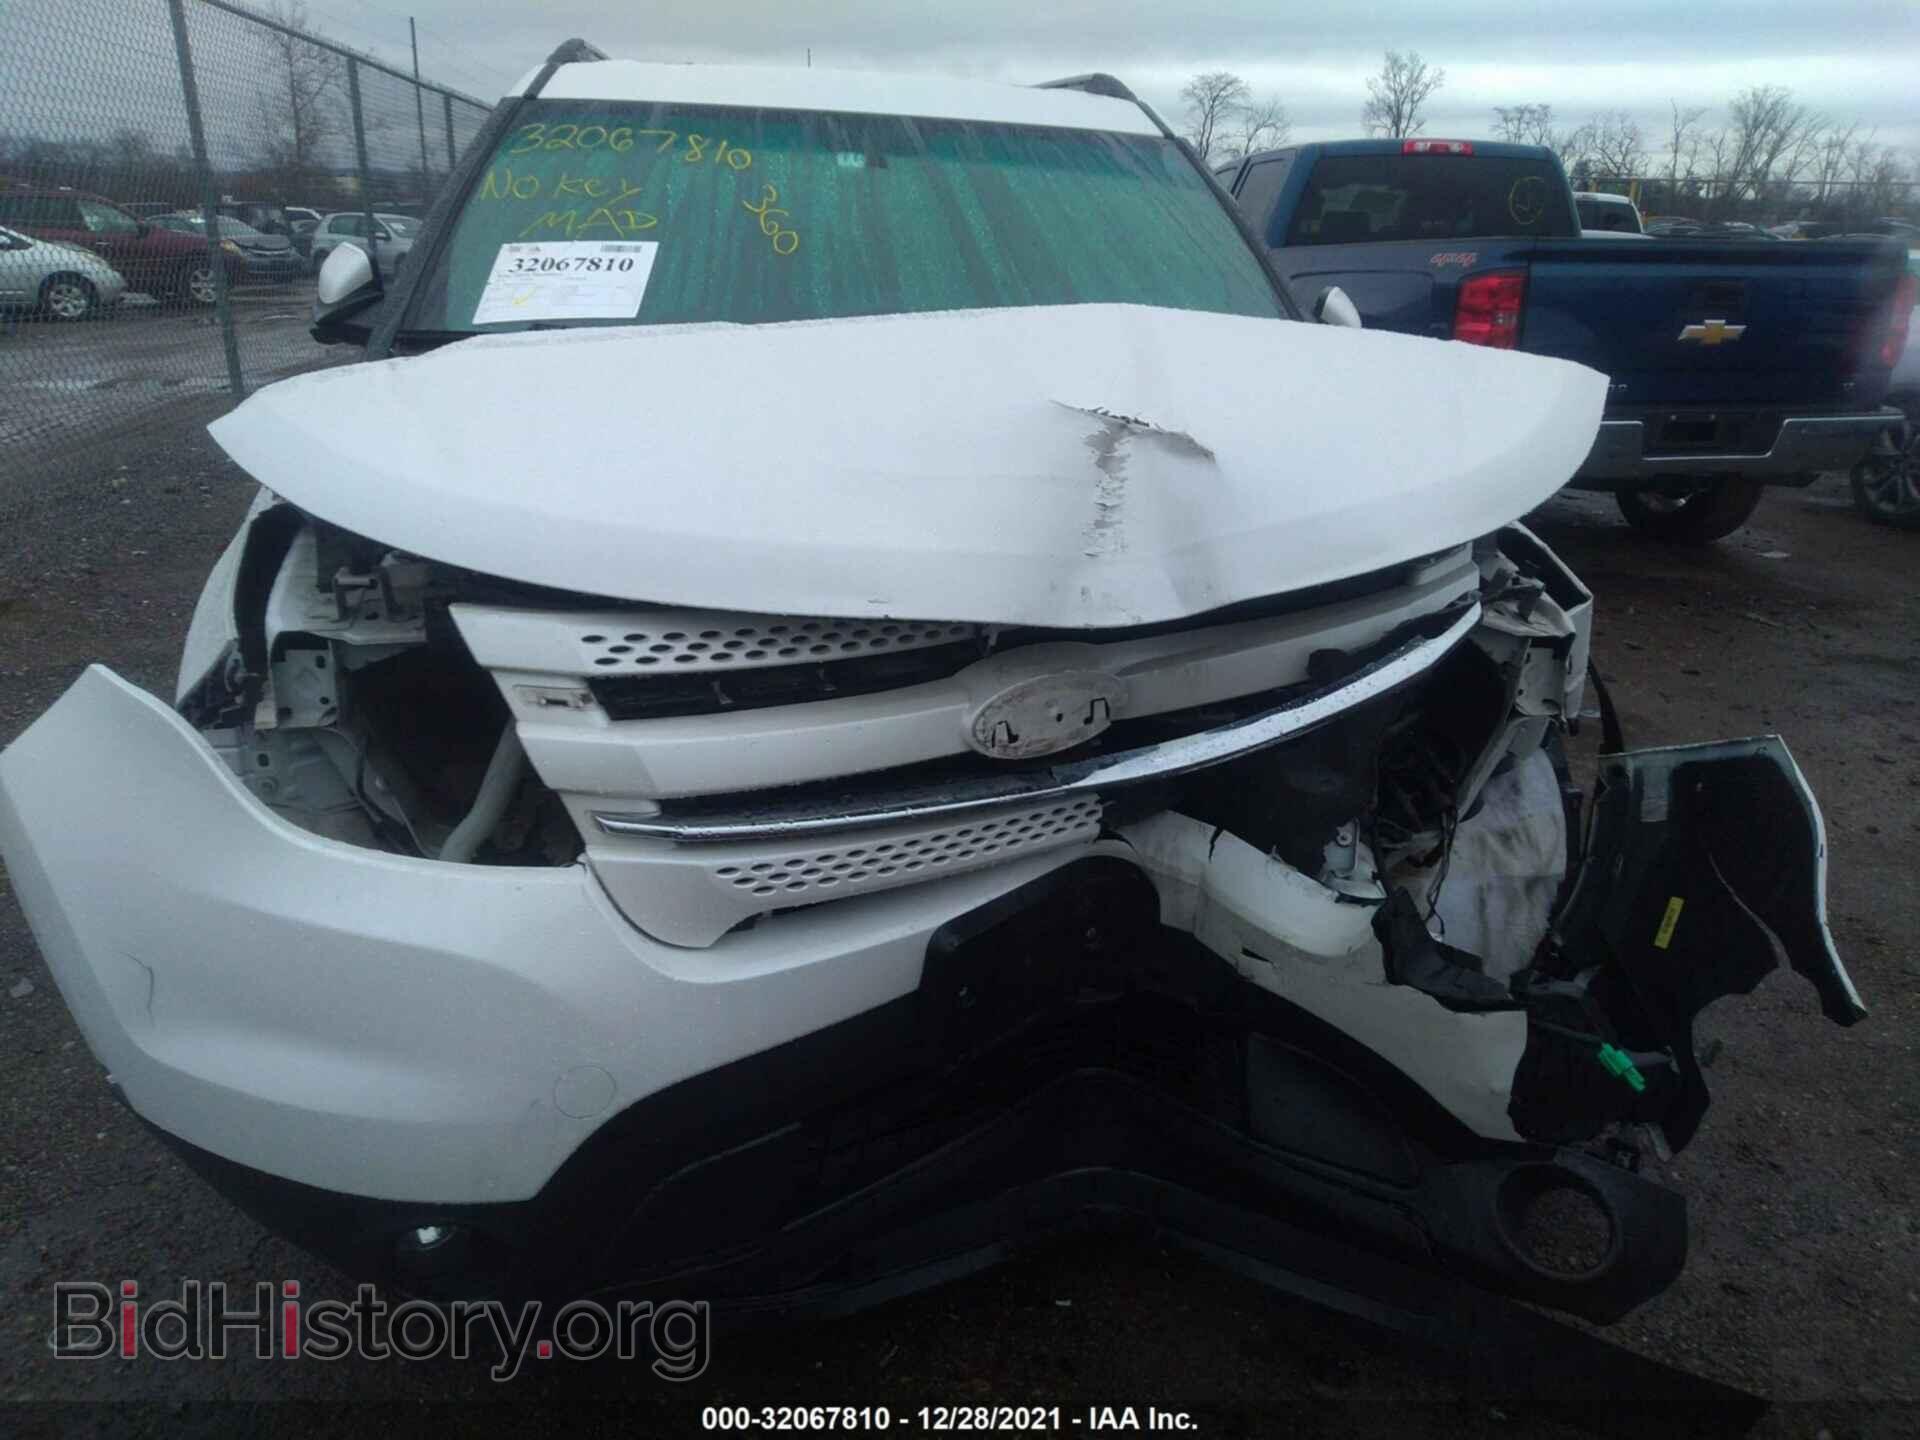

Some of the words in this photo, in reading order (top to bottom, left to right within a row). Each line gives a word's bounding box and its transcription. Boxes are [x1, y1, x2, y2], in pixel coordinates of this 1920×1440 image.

[509, 123, 752, 170] 32067810
[480, 168, 540, 201] NO
[743, 183, 799, 255] 360
[508, 256, 635, 273] 32067810
